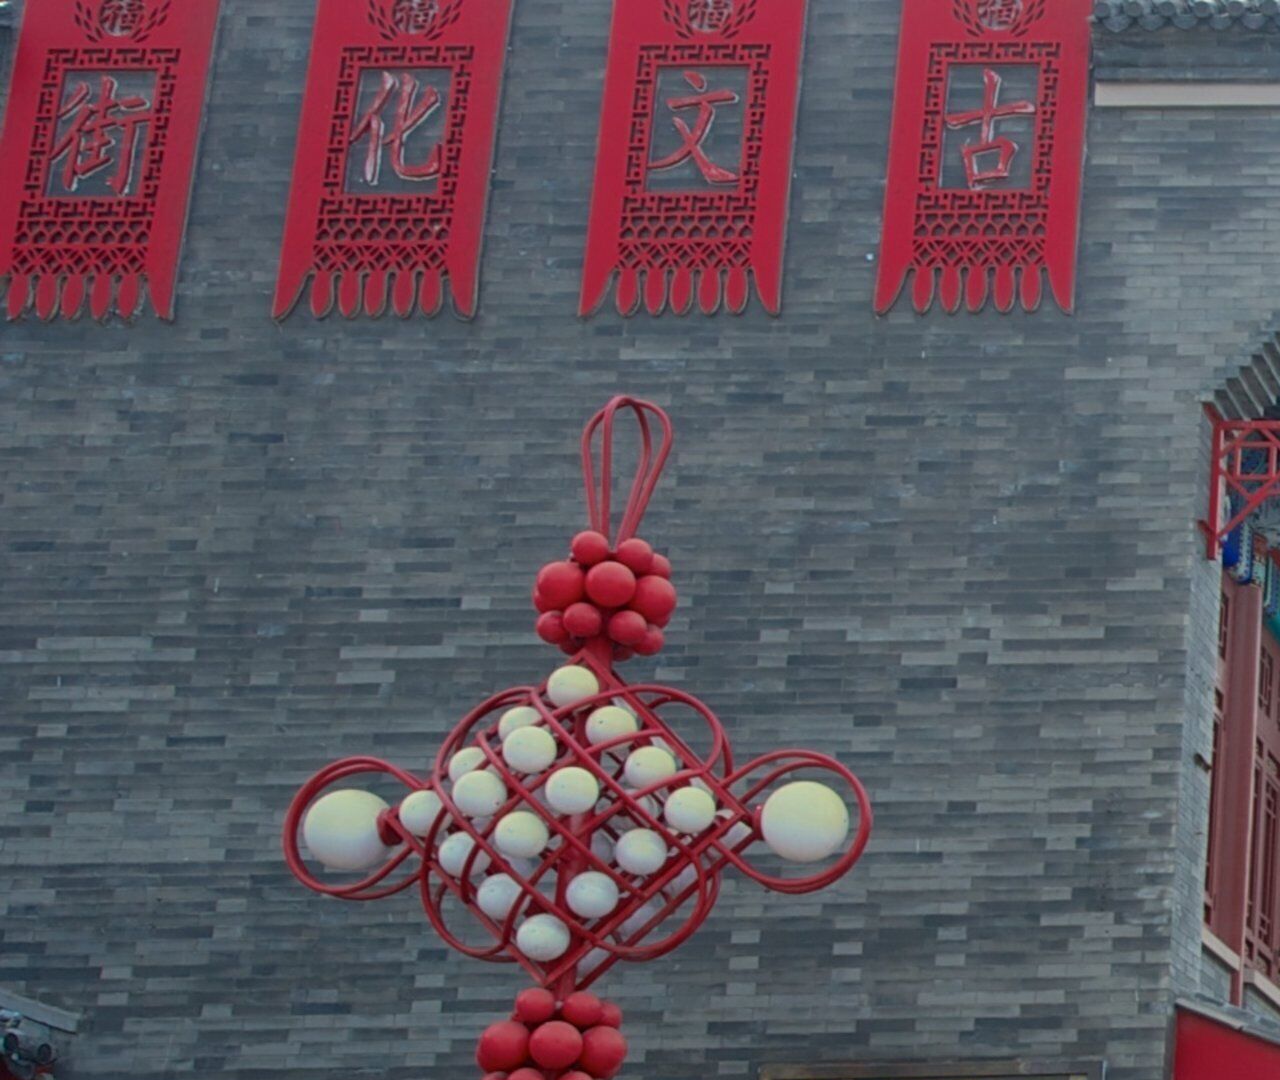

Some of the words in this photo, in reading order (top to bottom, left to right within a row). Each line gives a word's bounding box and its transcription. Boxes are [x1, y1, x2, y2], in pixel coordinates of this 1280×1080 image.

[48, 75, 151, 197] 街
[350, 70, 441, 186] 化
[646, 71, 741, 184] 文
[945, 68, 1036, 190] 古
